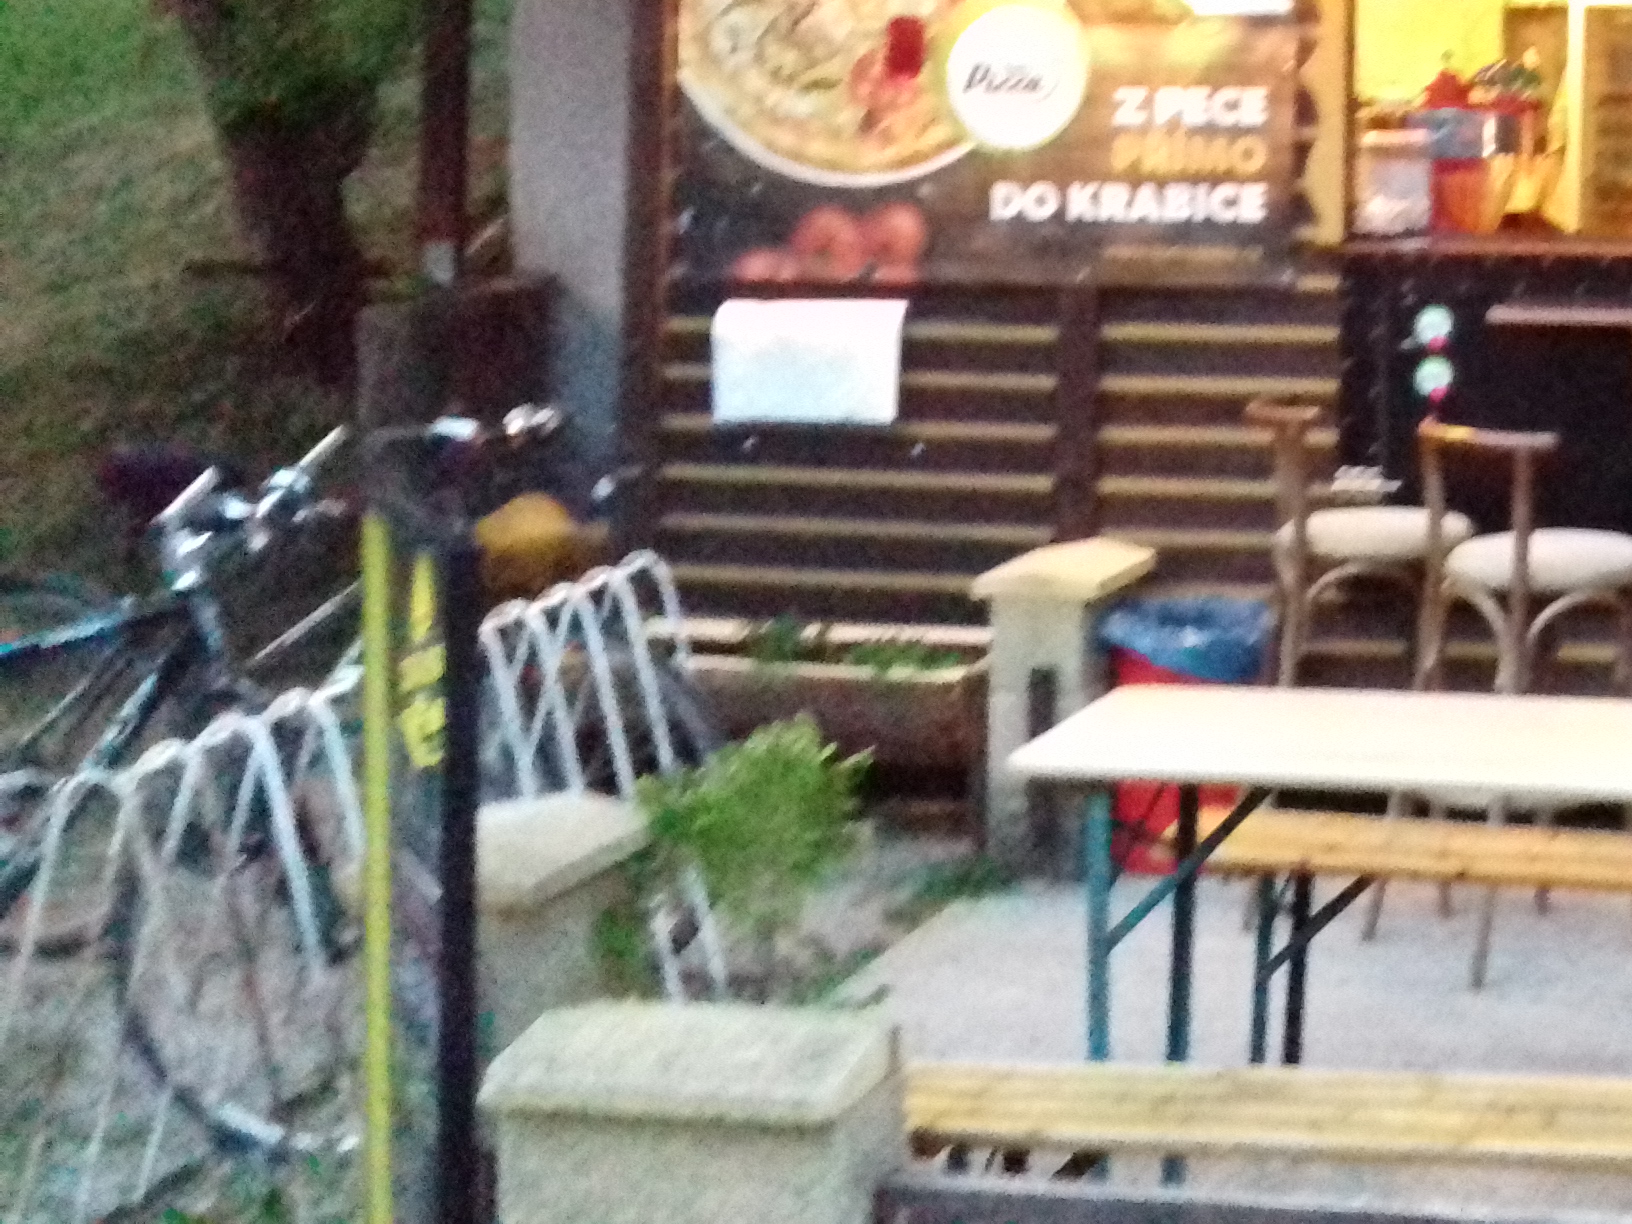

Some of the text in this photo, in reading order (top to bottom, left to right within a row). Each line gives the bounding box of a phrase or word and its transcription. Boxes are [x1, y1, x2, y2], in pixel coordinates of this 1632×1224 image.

[962, 61, 1054, 98] Pizza
[1111, 85, 1150, 127] Z
[989, 179, 1269, 224] DO KRABICE
